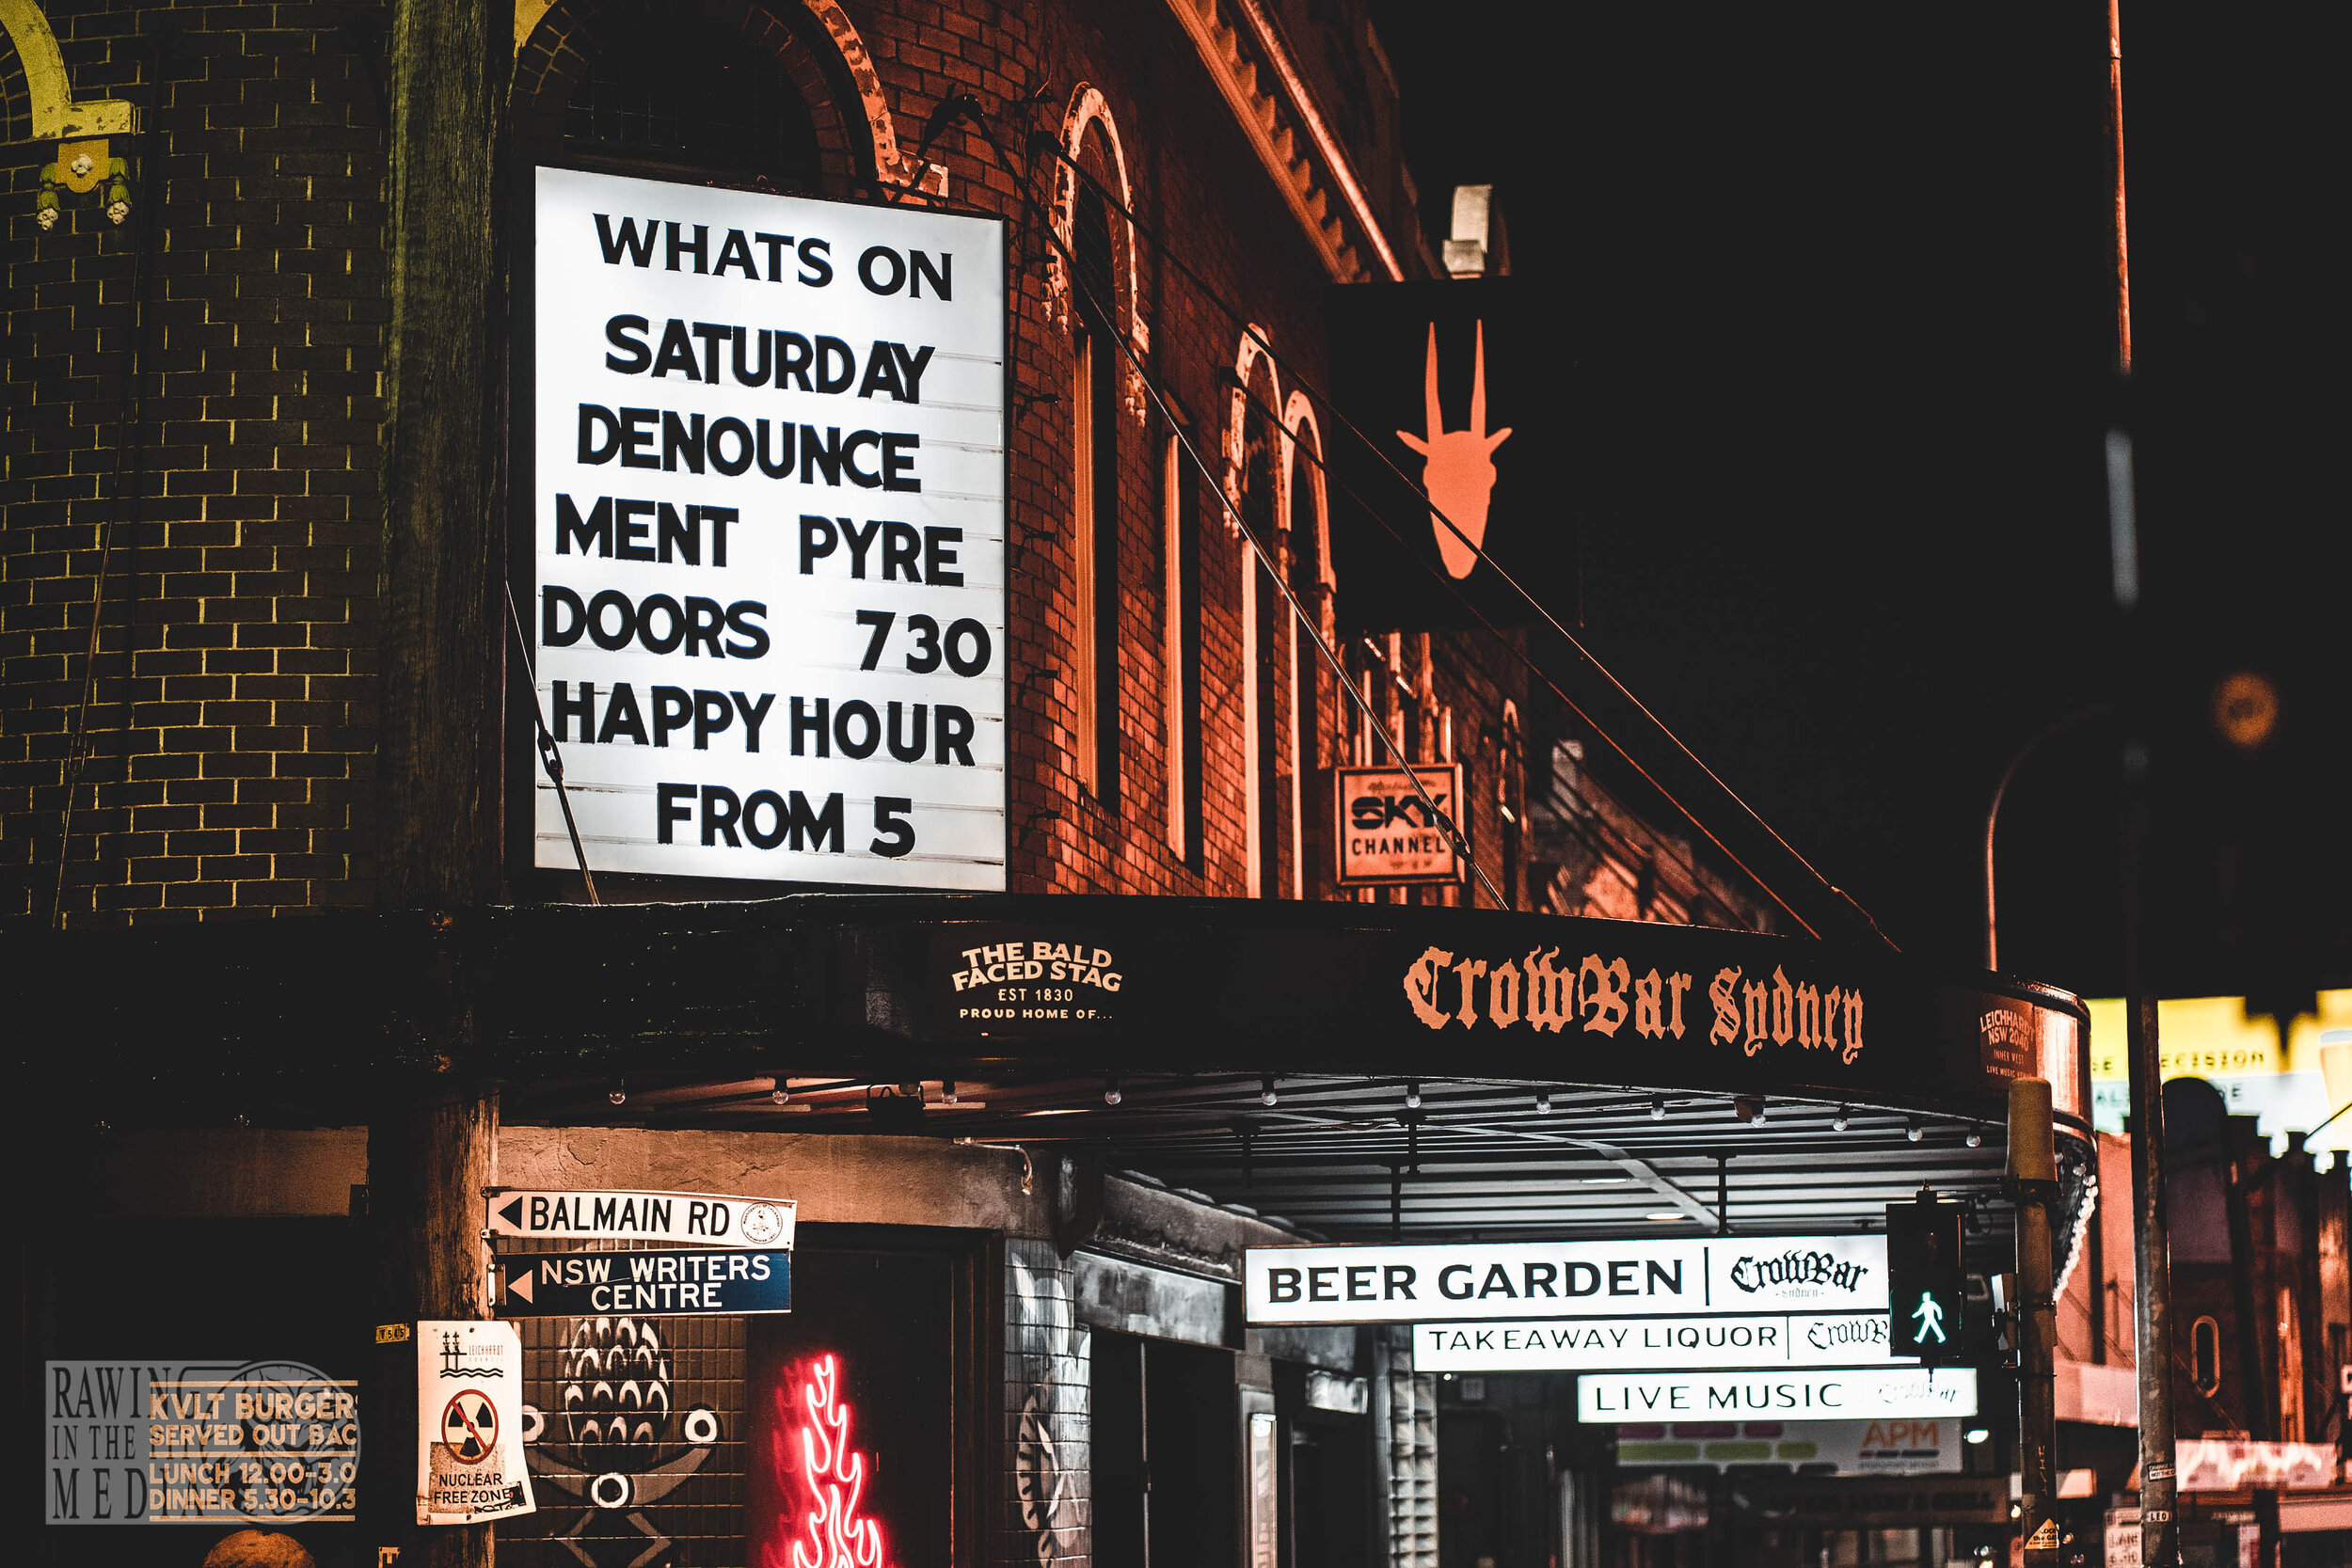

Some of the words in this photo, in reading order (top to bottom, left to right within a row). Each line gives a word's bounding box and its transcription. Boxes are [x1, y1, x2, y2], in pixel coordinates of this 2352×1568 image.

[592, 213, 834, 288] WHATS
[857, 245, 953, 302] ON
[605, 313, 935, 404] SATURDAY
[577, 403, 921, 493] DENOUNCE
[555, 493, 739, 567] MENT
[799, 514, 964, 587] PYRE
[542, 584, 771, 659] DOORS
[855, 610, 992, 677] 730
[551, 679, 775, 752] HAPPY
[788, 696, 976, 767] HOUR
[656, 782, 845, 852] FROM
[869, 796, 915, 858] 5
[1352, 794, 1448, 830] SKY
[1352, 836, 1446, 856] CHANNEL
[961, 942, 1025, 968] THE
[1032, 942, 1113, 968] BALD
[951, 960, 1043, 992] FACED
[1050, 960, 1123, 992] STAG
[997, 988, 1027, 1002] EST
[1035, 989, 1073, 1002] 1830
[960, 1008, 1016, 1019] PROUD
[1022, 1008, 1069, 1019] HOME
[1708, 964, 1864, 1065] Sydney
[1979, 1009, 2035, 1042] LEICHHARDT
[1988, 1026, 2008, 1046] NSW
[2009, 1027, 2029, 1052] 2040
[530, 1196, 673, 1233] BALMAIN
[688, 1200, 729, 1236] RD
[541, 1259, 612, 1285] NSW
[629, 1255, 771, 1282] WRITERS
[1268, 1265, 1418, 1304] BEER
[1438, 1259, 1683, 1301] GARDEN
[591, 1282, 723, 1311] CENTRE
[1429, 1328, 1628, 1351] TAKEAWAY
[1645, 1326, 1777, 1348] LIQUOR
[150, 1393, 225, 1420] KVLT
[1597, 1386, 1691, 1410] LIVE
[1708, 1384, 1842, 1409] MUSIC
[150, 1424, 245, 1446] SERVED
[252, 1424, 306, 1446] OUT
[1861, 1420, 1939, 1448] APM
[150, 1463, 230, 1484] LUNCH
[438, 1473, 503, 1486] NUCLEAR
[150, 1488, 236, 1511] DINNER
[434, 1490, 468, 1504] FREE
[470, 1488, 510, 1503] ZONE
